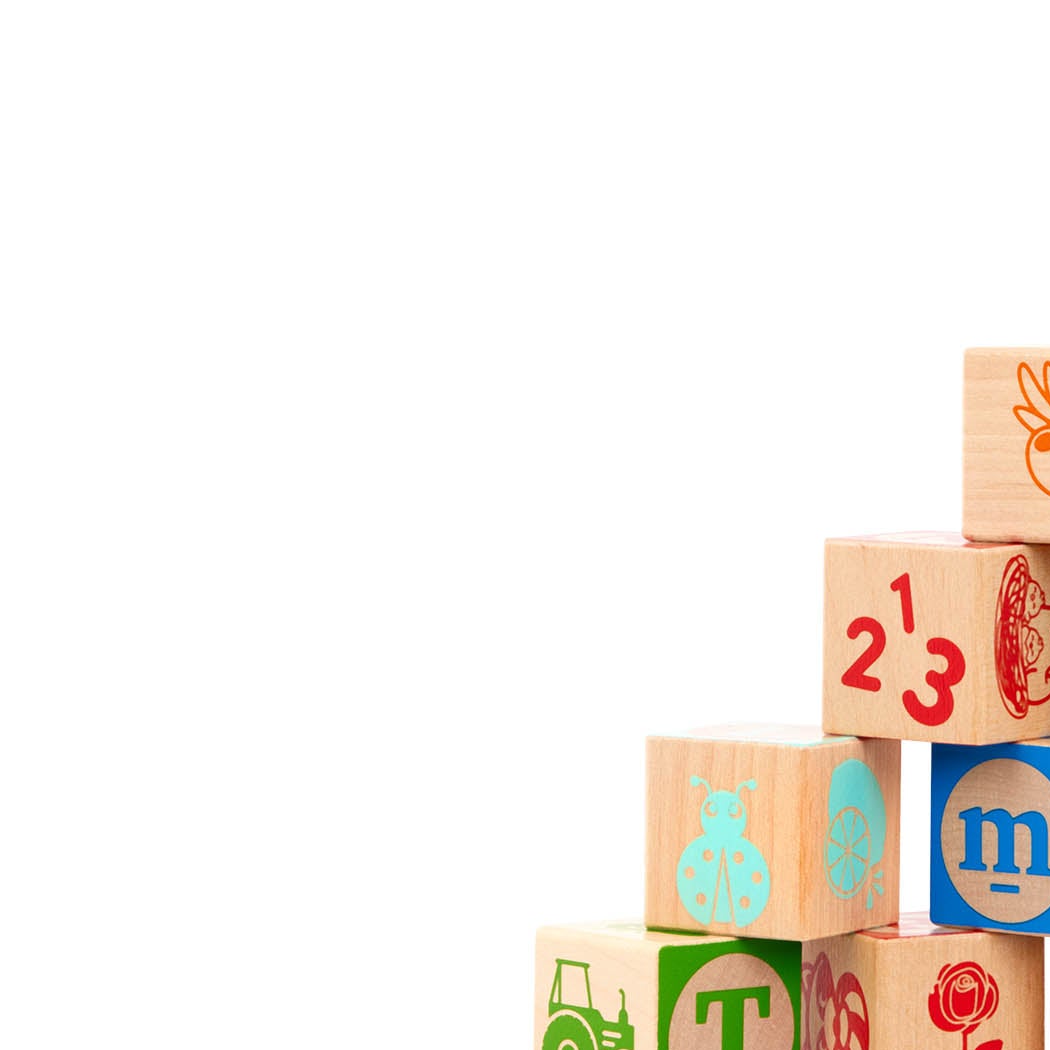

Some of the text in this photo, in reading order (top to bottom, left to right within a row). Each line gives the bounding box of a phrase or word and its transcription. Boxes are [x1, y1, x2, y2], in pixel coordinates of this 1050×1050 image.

[890, 573, 914, 633] 1
[842, 617, 886, 692] 2
[902, 637, 966, 726] 3
